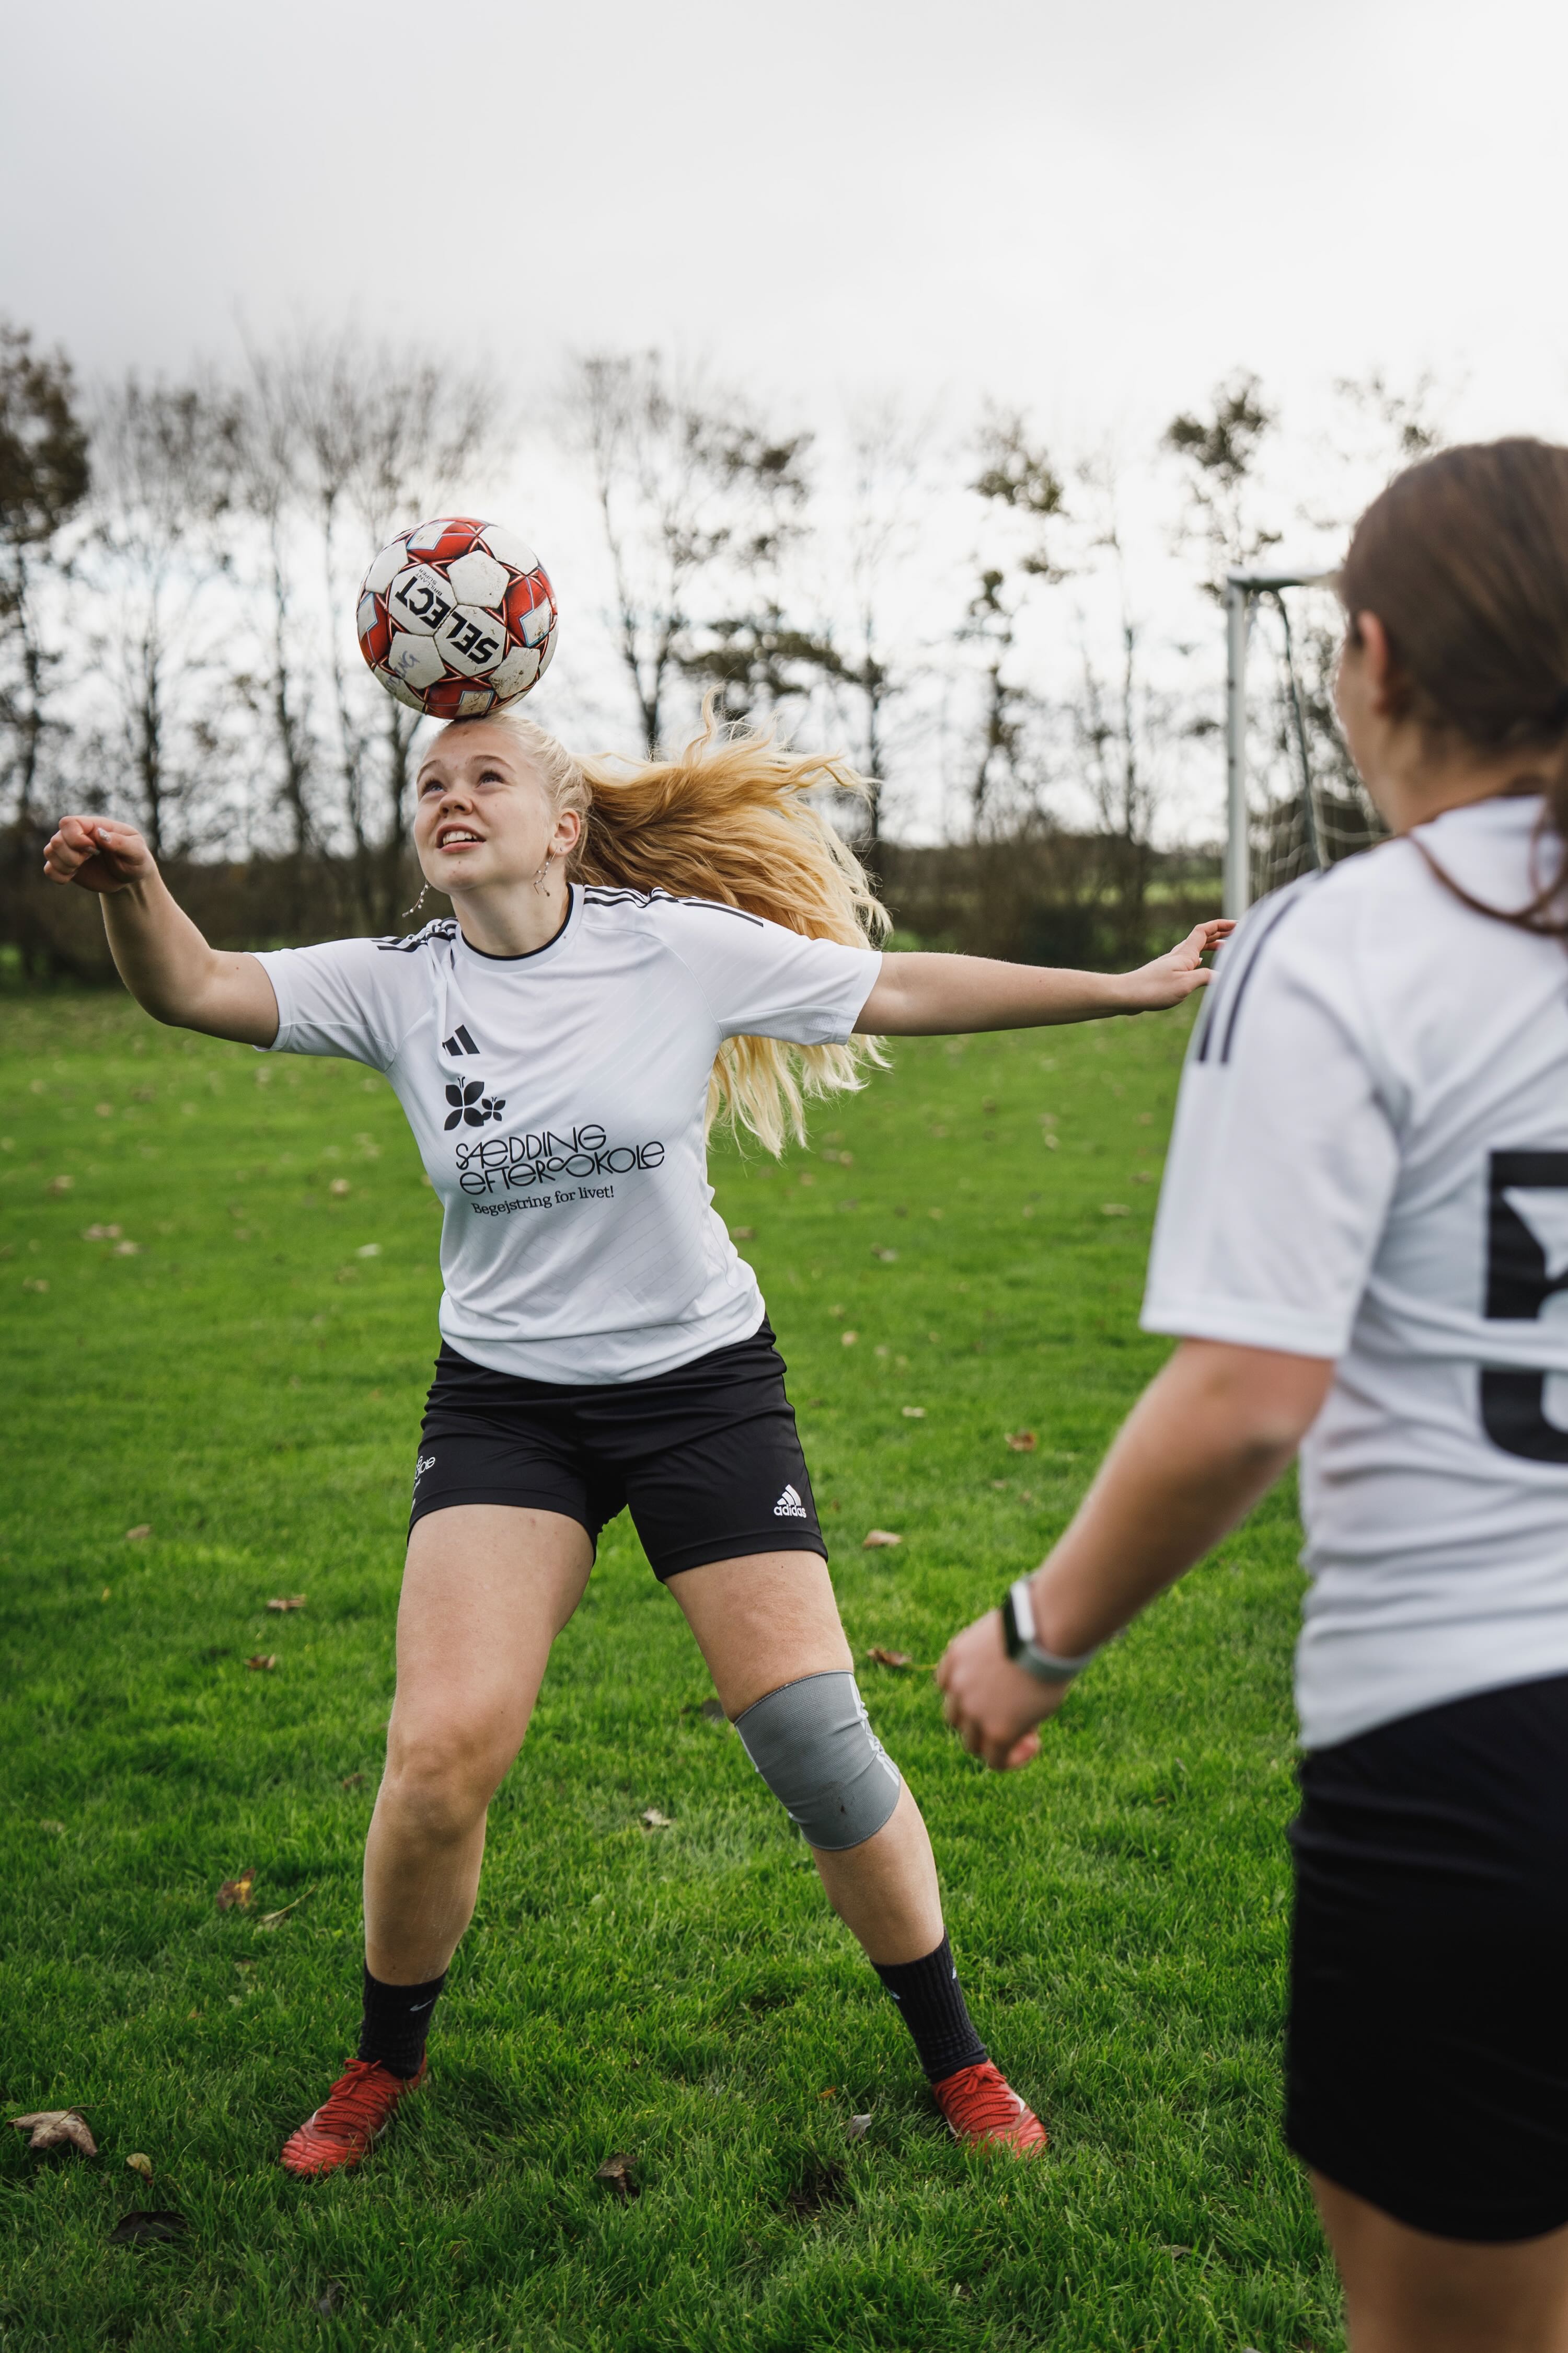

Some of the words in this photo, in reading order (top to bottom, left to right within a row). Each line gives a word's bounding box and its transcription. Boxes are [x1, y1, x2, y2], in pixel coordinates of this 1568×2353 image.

[416, 572, 443, 596] BRILLANT
[419, 568, 437, 585] SUPER
[395, 576, 500, 664] SELECT
[471, 1195, 552, 1216] Begejstring
[555, 1190, 576, 1203] for
[578, 1185, 615, 1199] livet!
[773, 1504, 807, 1518] adidas
